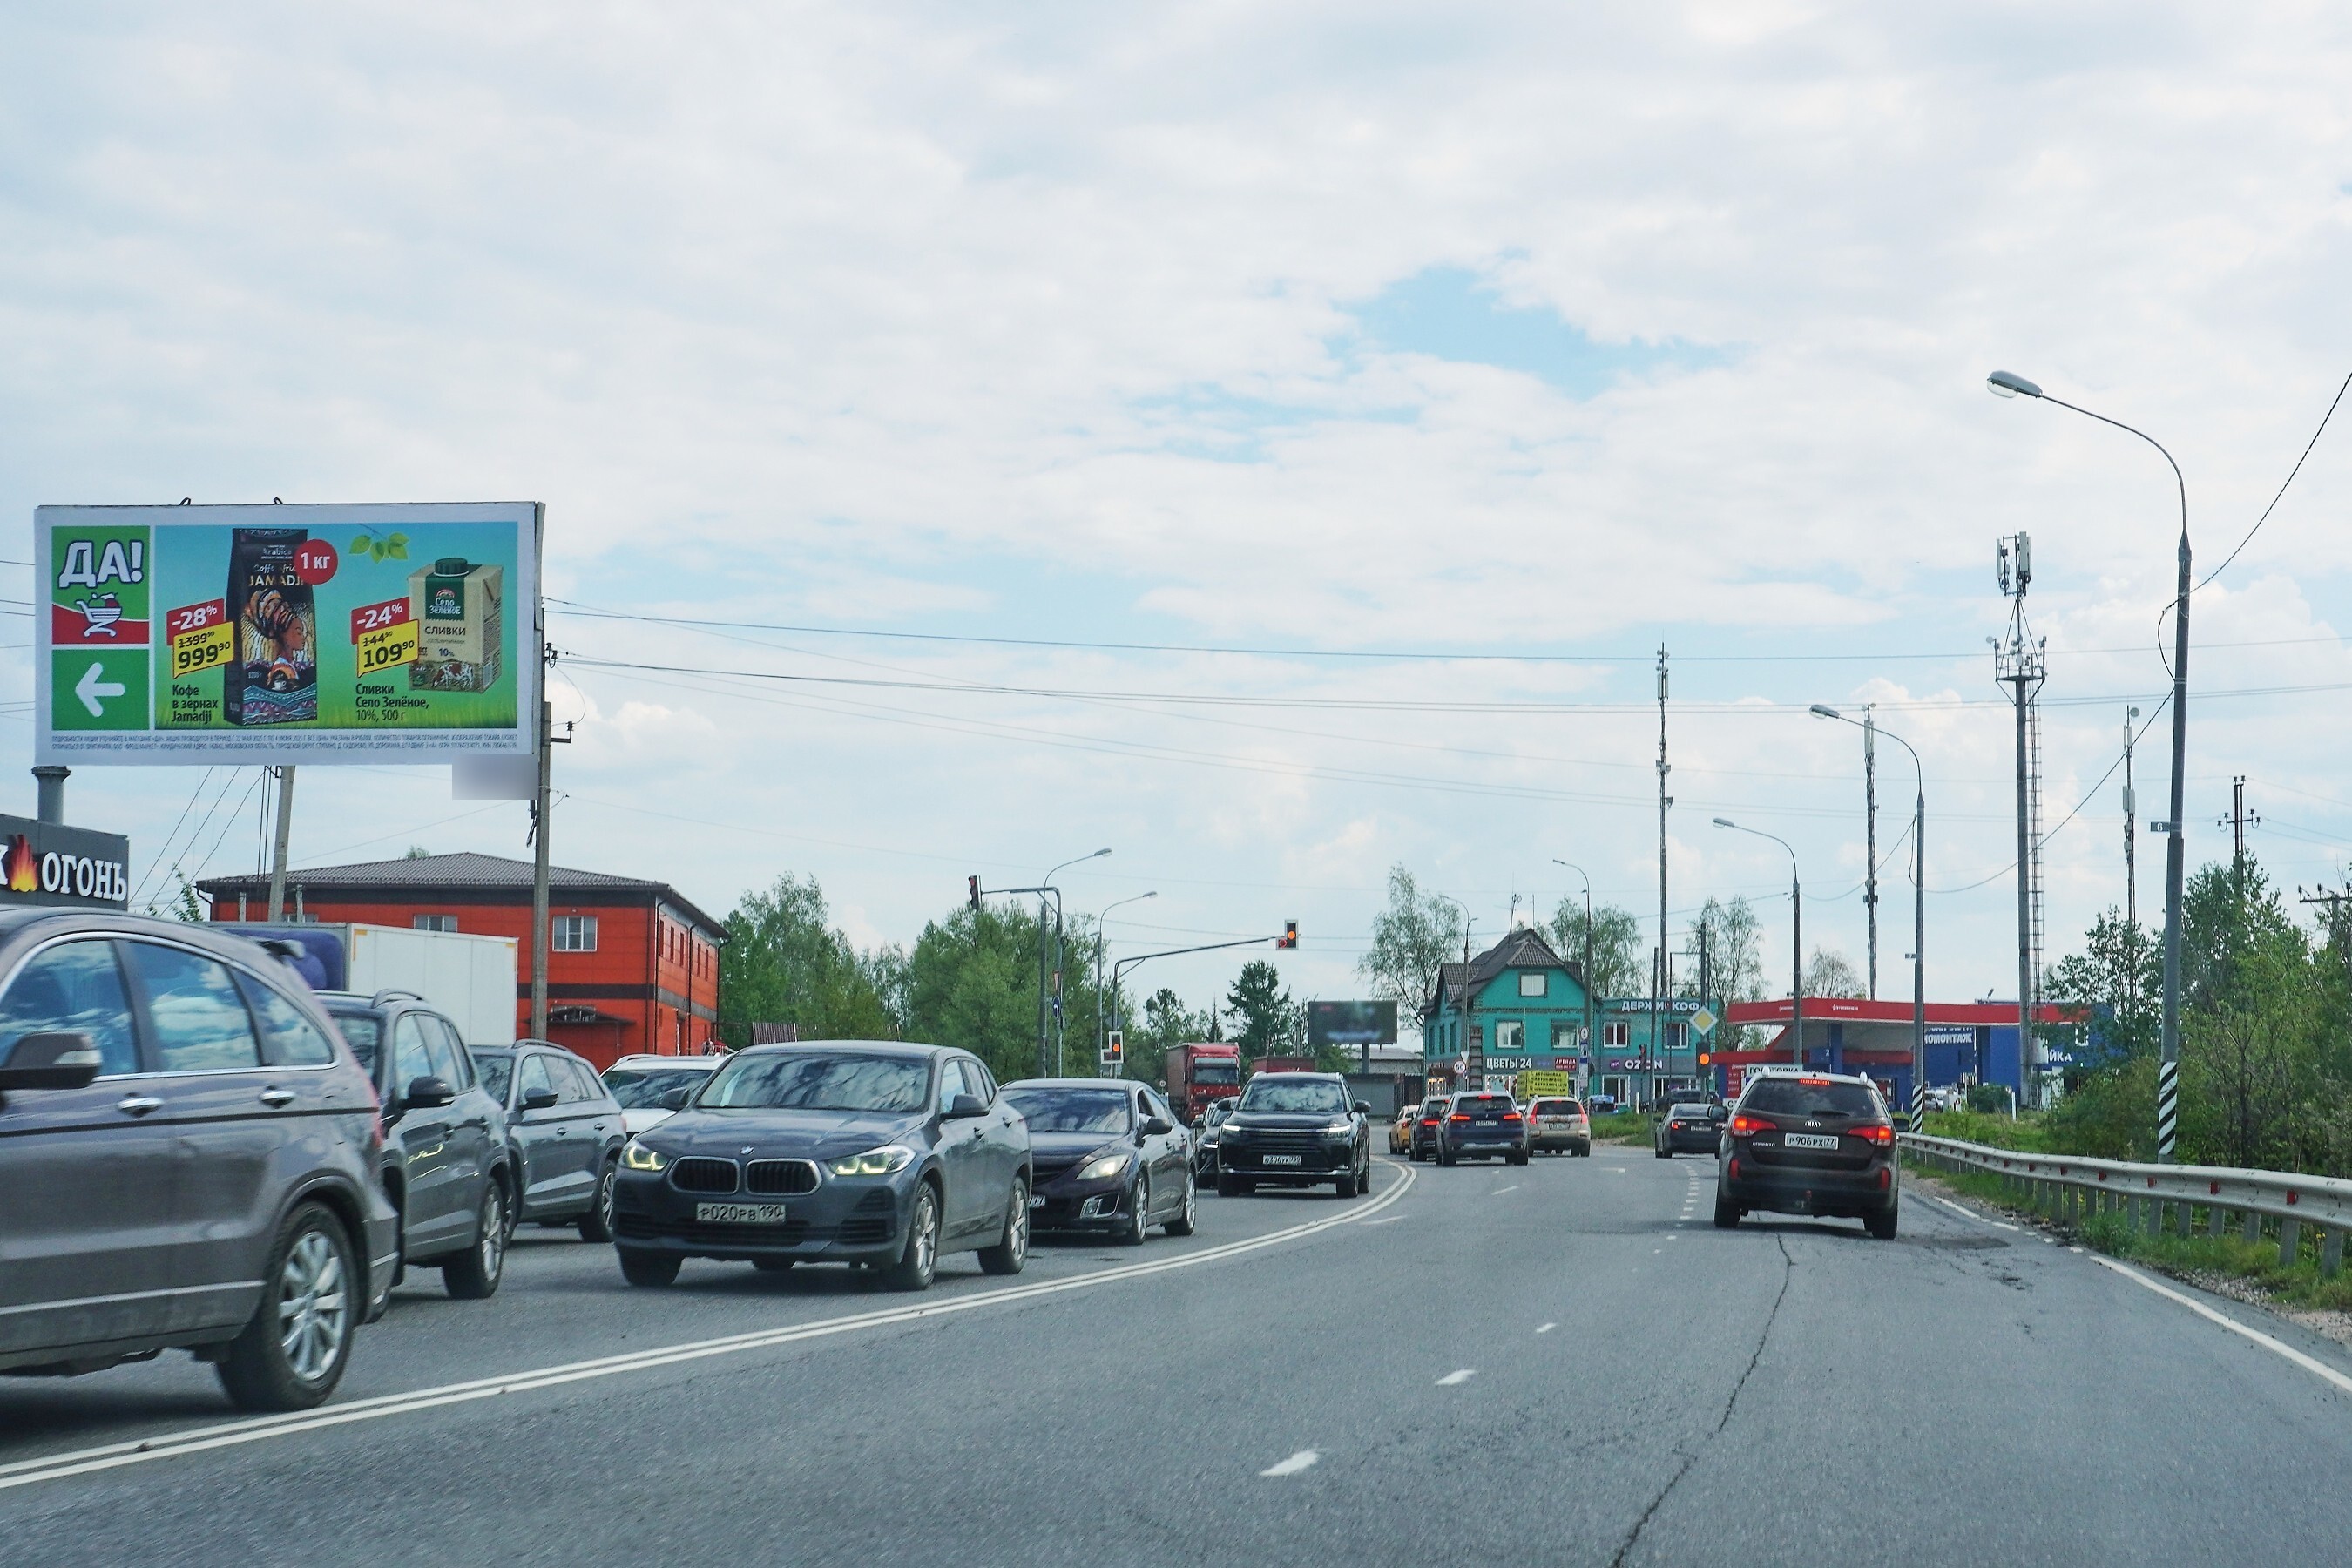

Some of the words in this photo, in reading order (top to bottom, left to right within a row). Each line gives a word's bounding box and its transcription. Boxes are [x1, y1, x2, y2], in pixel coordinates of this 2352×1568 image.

[57, 539, 144, 590] ДА!
[301, 552, 308, 569] 1
[314, 556, 330, 569] кг
[435, 598, 455, 606] Село
[172, 605, 217, 631] -28%
[356, 603, 403, 629] -24%
[424, 626, 466, 636] СЛИВКИ
[172, 685, 199, 699] Кофе
[355, 683, 395, 695] Сливки
[172, 700, 179, 709] в
[180, 700, 218, 713] зернах
[355, 697, 381, 708] Село
[382, 696, 429, 710] Зелёное,
[171, 709, 213, 725] Jamadji
[356, 710, 380, 723] 10%,
[381, 710, 400, 722] 500
[401, 713, 407, 721] г
[42, 851, 127, 901] ОГОНЬ
[1673, 1001, 1701, 1010] КОФ
[1486, 1058, 1517, 1070] ЦВЕТЫ
[1520, 1058, 1532, 1069] 24
